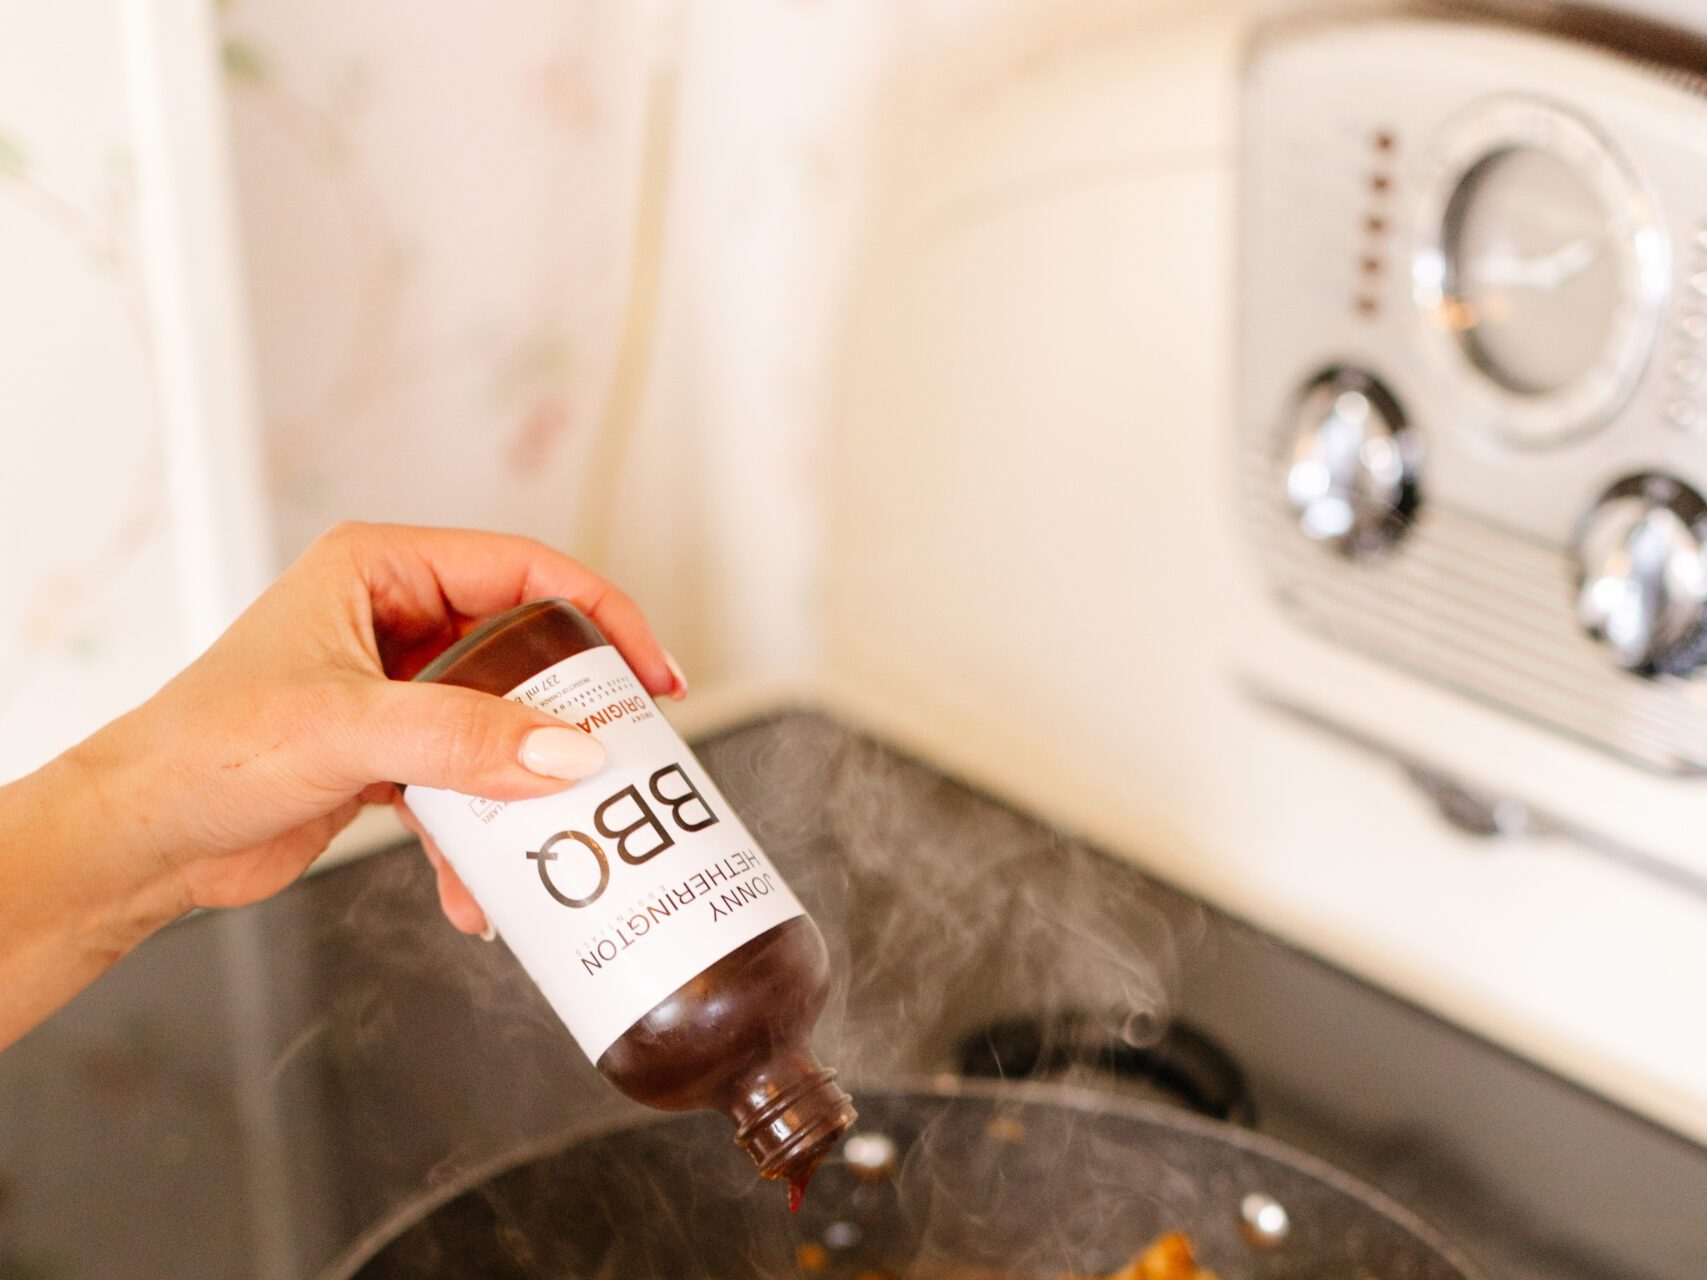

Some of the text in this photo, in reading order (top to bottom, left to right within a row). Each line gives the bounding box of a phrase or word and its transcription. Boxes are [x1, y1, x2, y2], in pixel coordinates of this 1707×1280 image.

[525, 686, 540, 701] ml
[543, 674, 561, 692] 237
[576, 695, 647, 734] ORIGINA
[526, 762, 720, 909] BBQ
[581, 848, 762, 976] HETHERINGTON
[709, 872, 776, 922] JONNY
